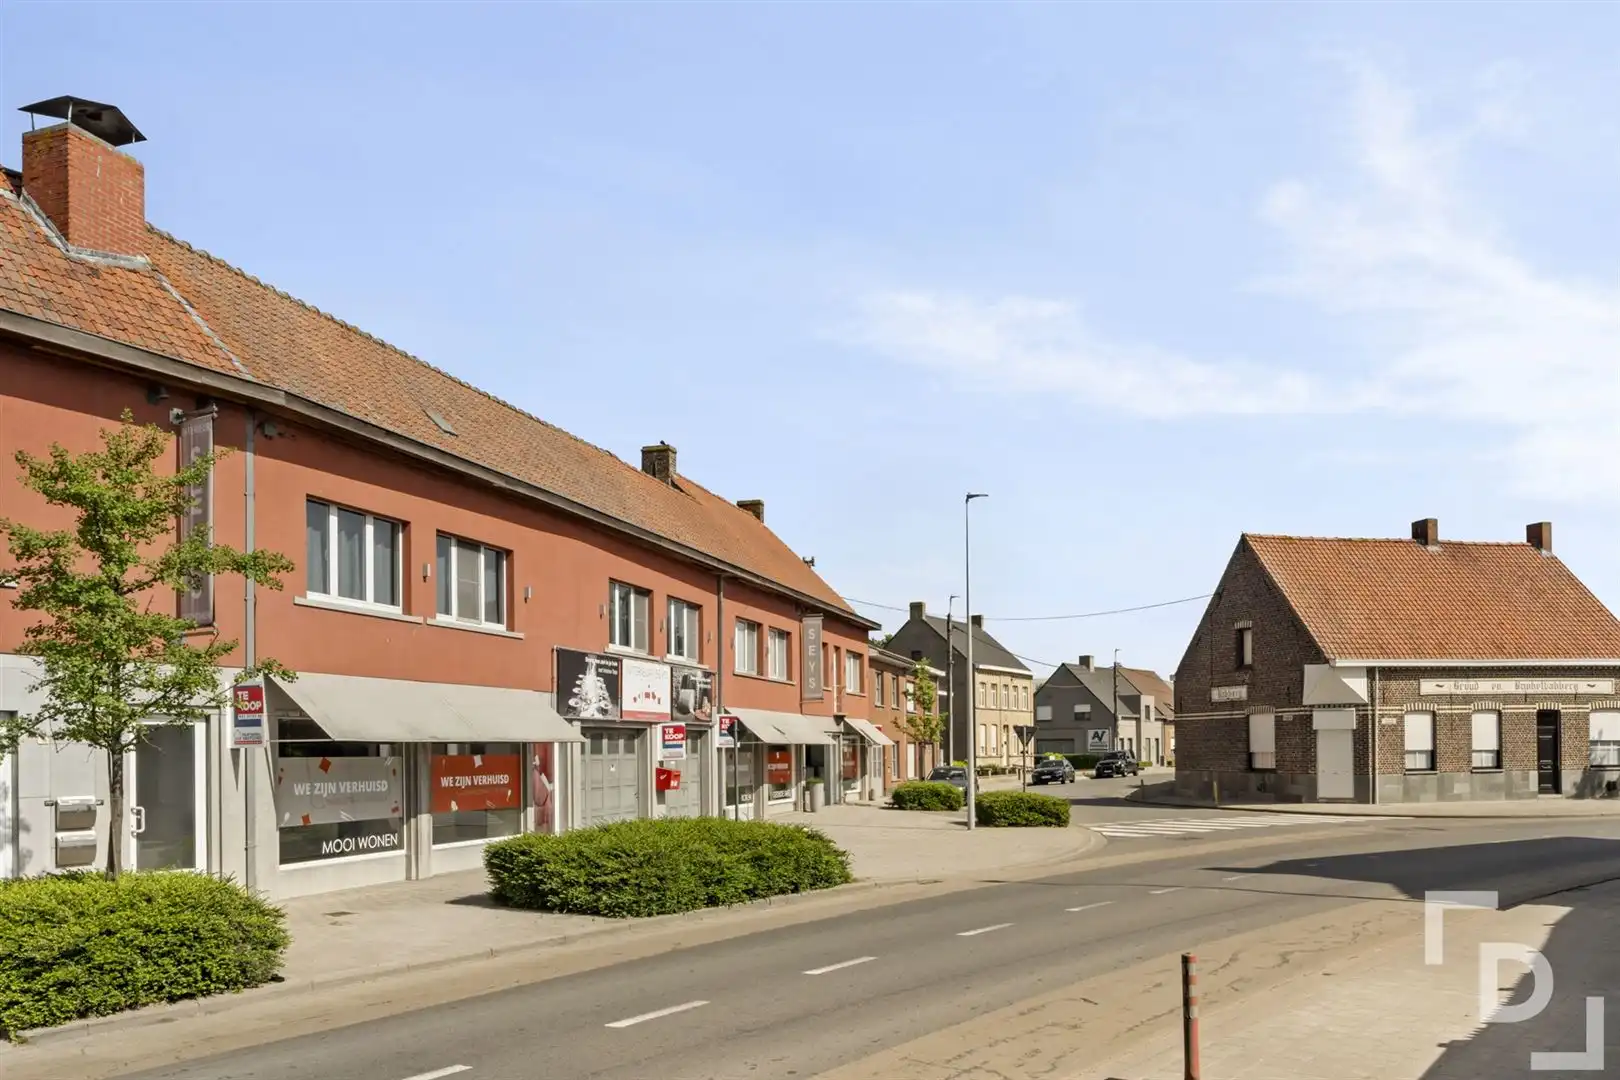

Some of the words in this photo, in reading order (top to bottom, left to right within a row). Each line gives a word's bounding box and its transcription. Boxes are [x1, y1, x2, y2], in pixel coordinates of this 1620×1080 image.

[808, 628, 816, 690] SEYS
[237, 691, 249, 701] TE
[294, 783, 311, 796] WE
[314, 782, 337, 798] ZIJN
[339, 780, 389, 793] VERHUISD
[440, 776, 454, 788] WE
[455, 775, 472, 789] ZIJN
[473, 774, 510, 786] VERHUISD
[322, 838, 356, 855] MOOI
[357, 833, 399, 850] WONEN
